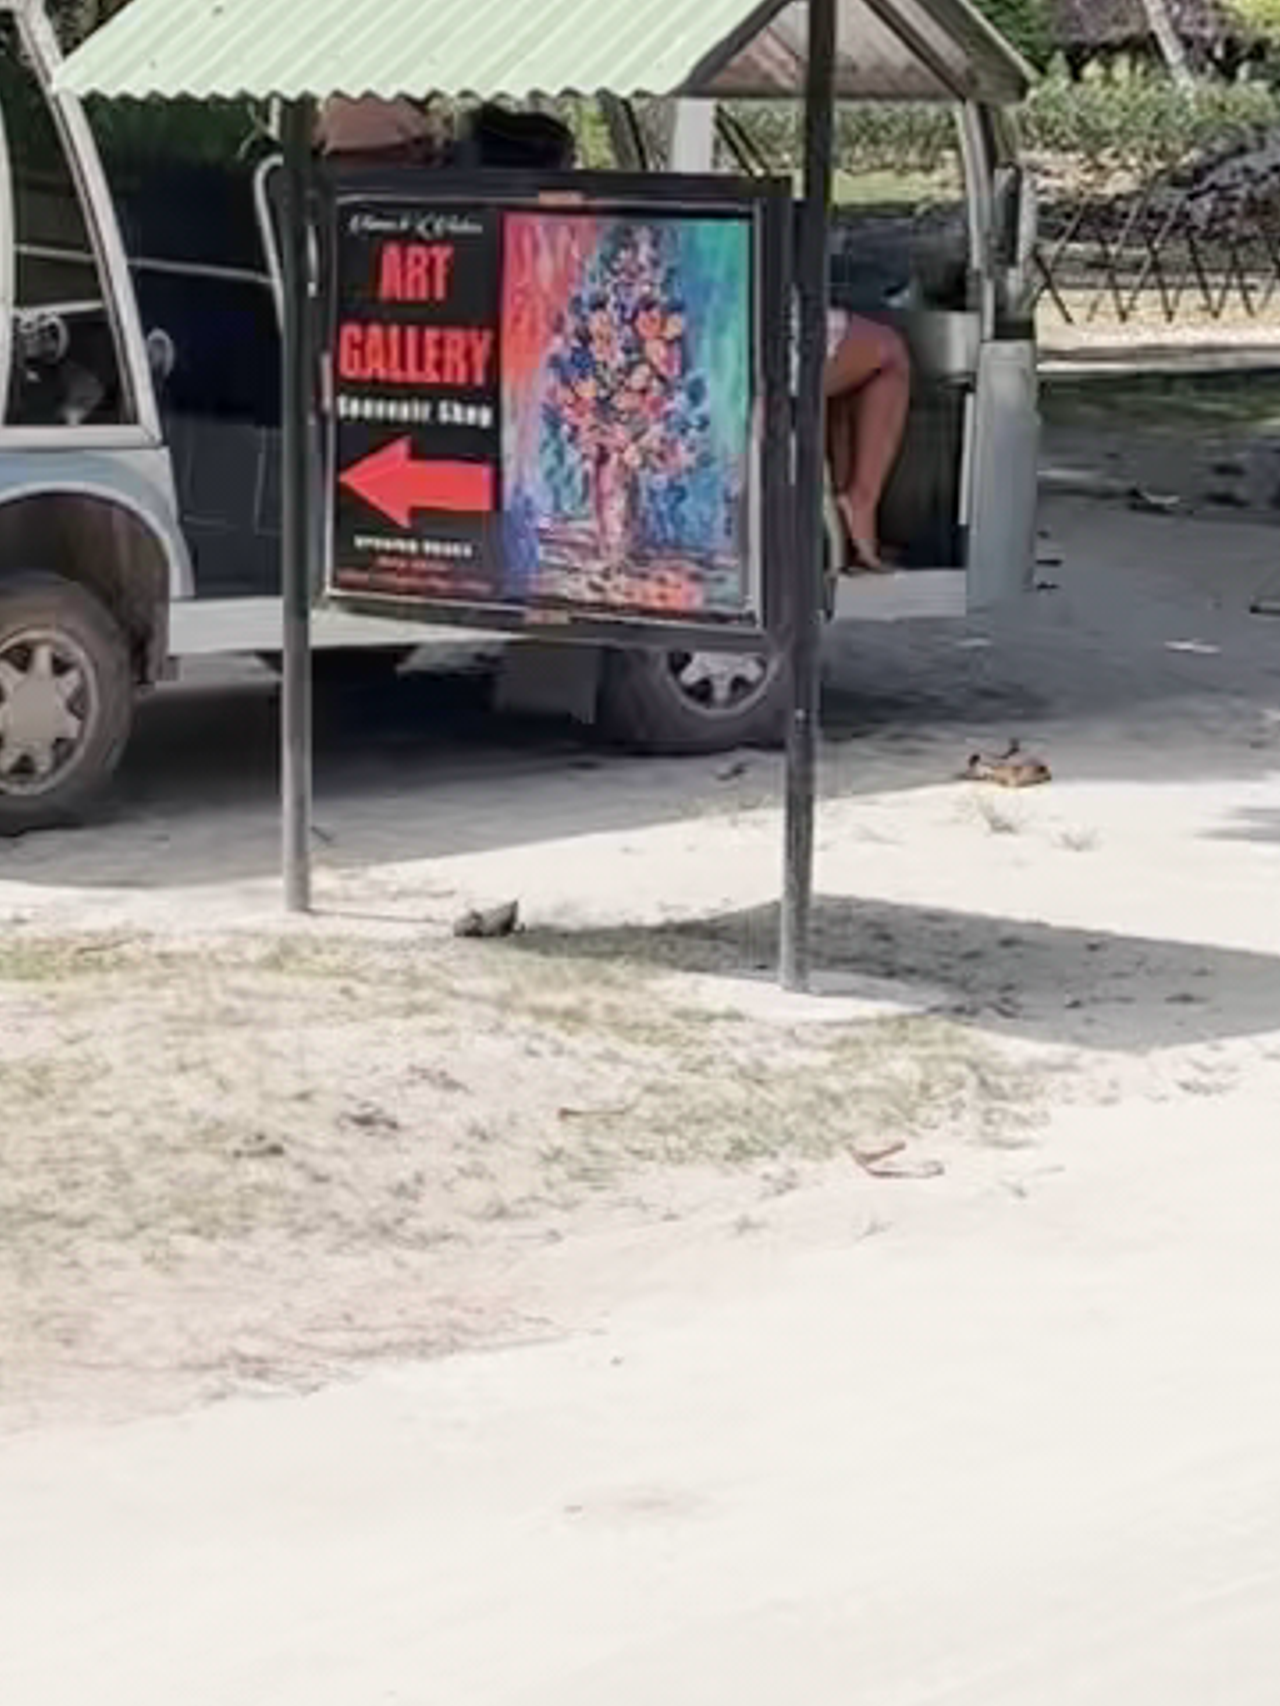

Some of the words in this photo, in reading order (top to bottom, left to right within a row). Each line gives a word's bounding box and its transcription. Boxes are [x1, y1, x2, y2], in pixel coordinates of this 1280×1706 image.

[380, 242, 454, 302] ART
[338, 322, 494, 386] GALLERY
[337, 394, 431, 423] Souvenir
[437, 399, 493, 429] Shop
